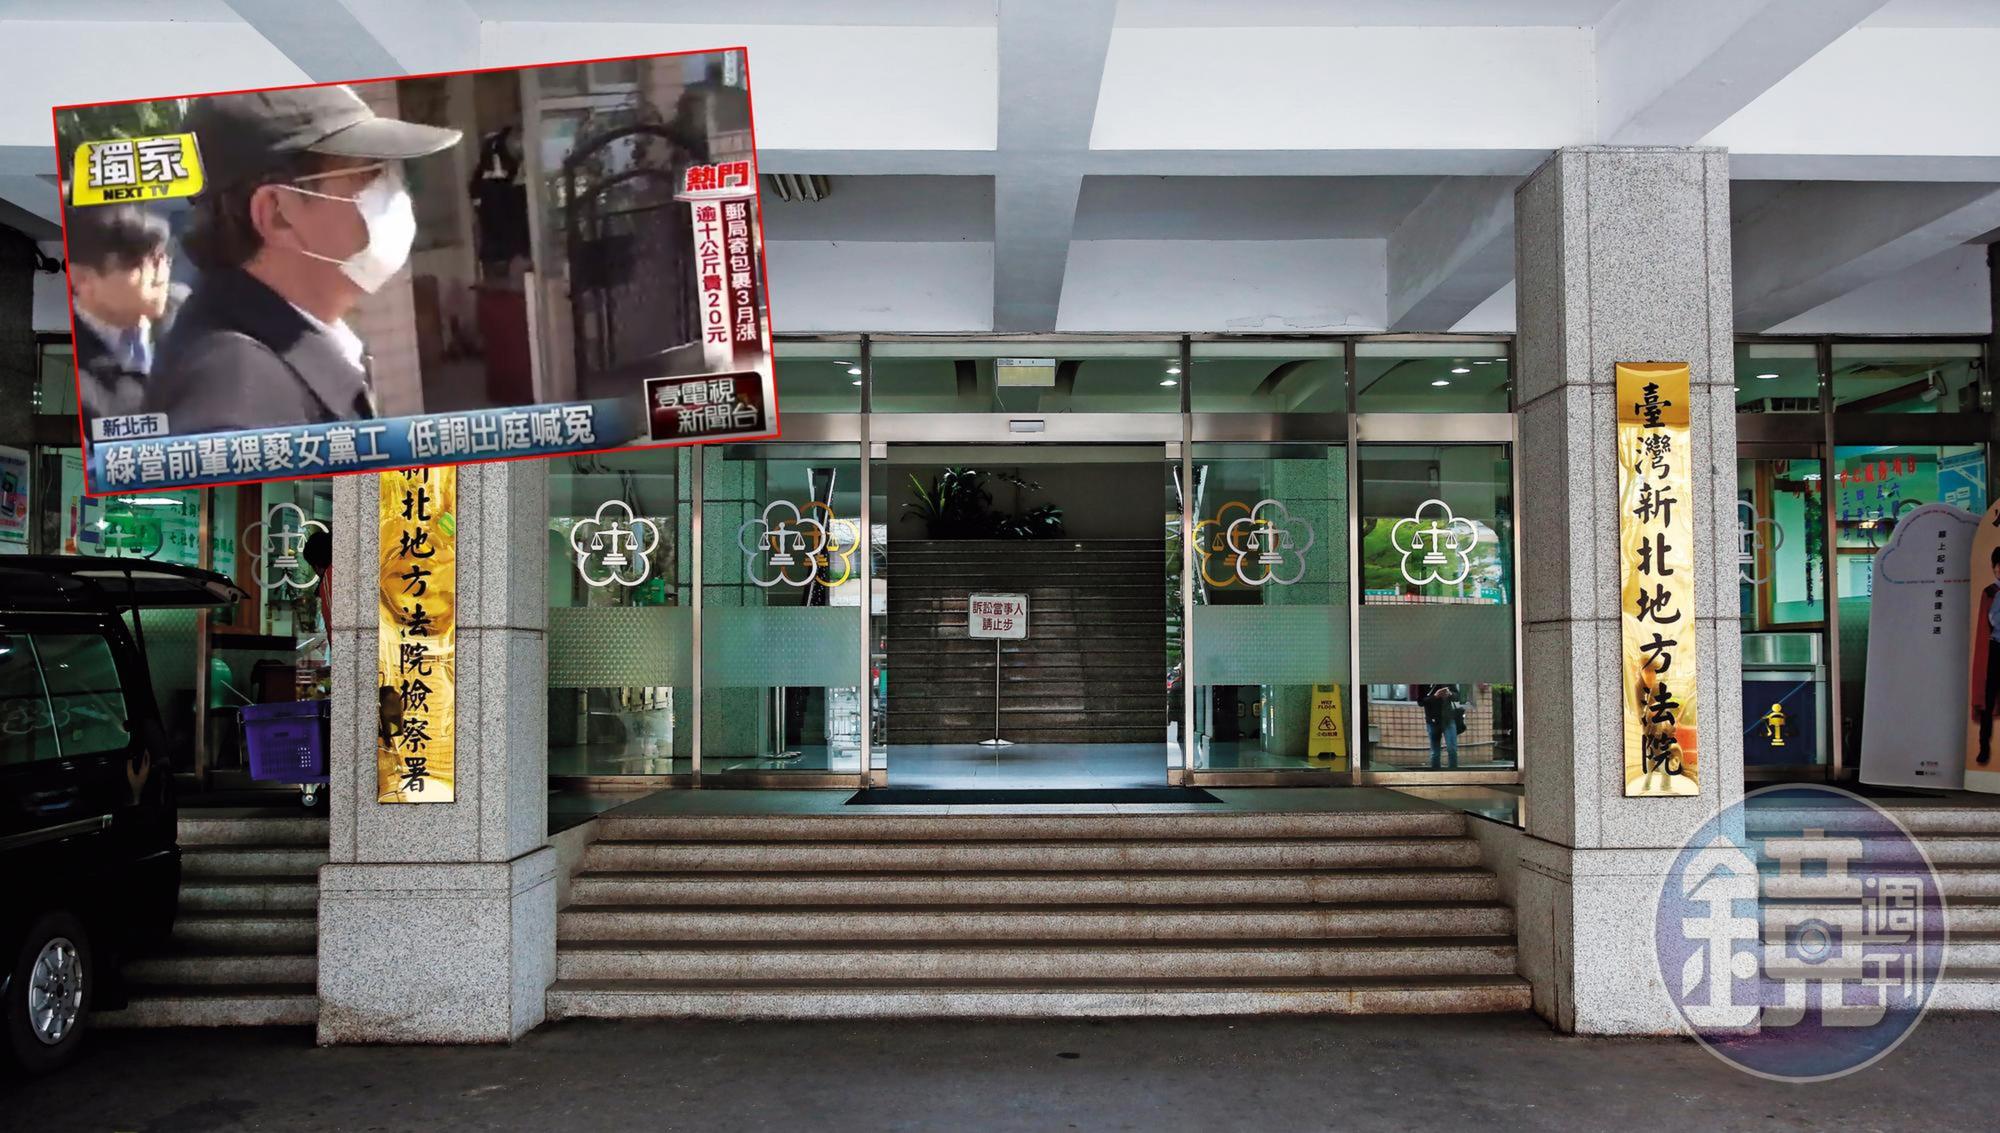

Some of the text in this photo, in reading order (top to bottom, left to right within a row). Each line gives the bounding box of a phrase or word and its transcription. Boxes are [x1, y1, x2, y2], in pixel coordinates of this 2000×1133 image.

[1633, 382, 1683, 776] 臺灣新北地方法院
[973, 601, 1023, 615] 訴訟當事人
[982, 618, 1013, 631] 請止步
